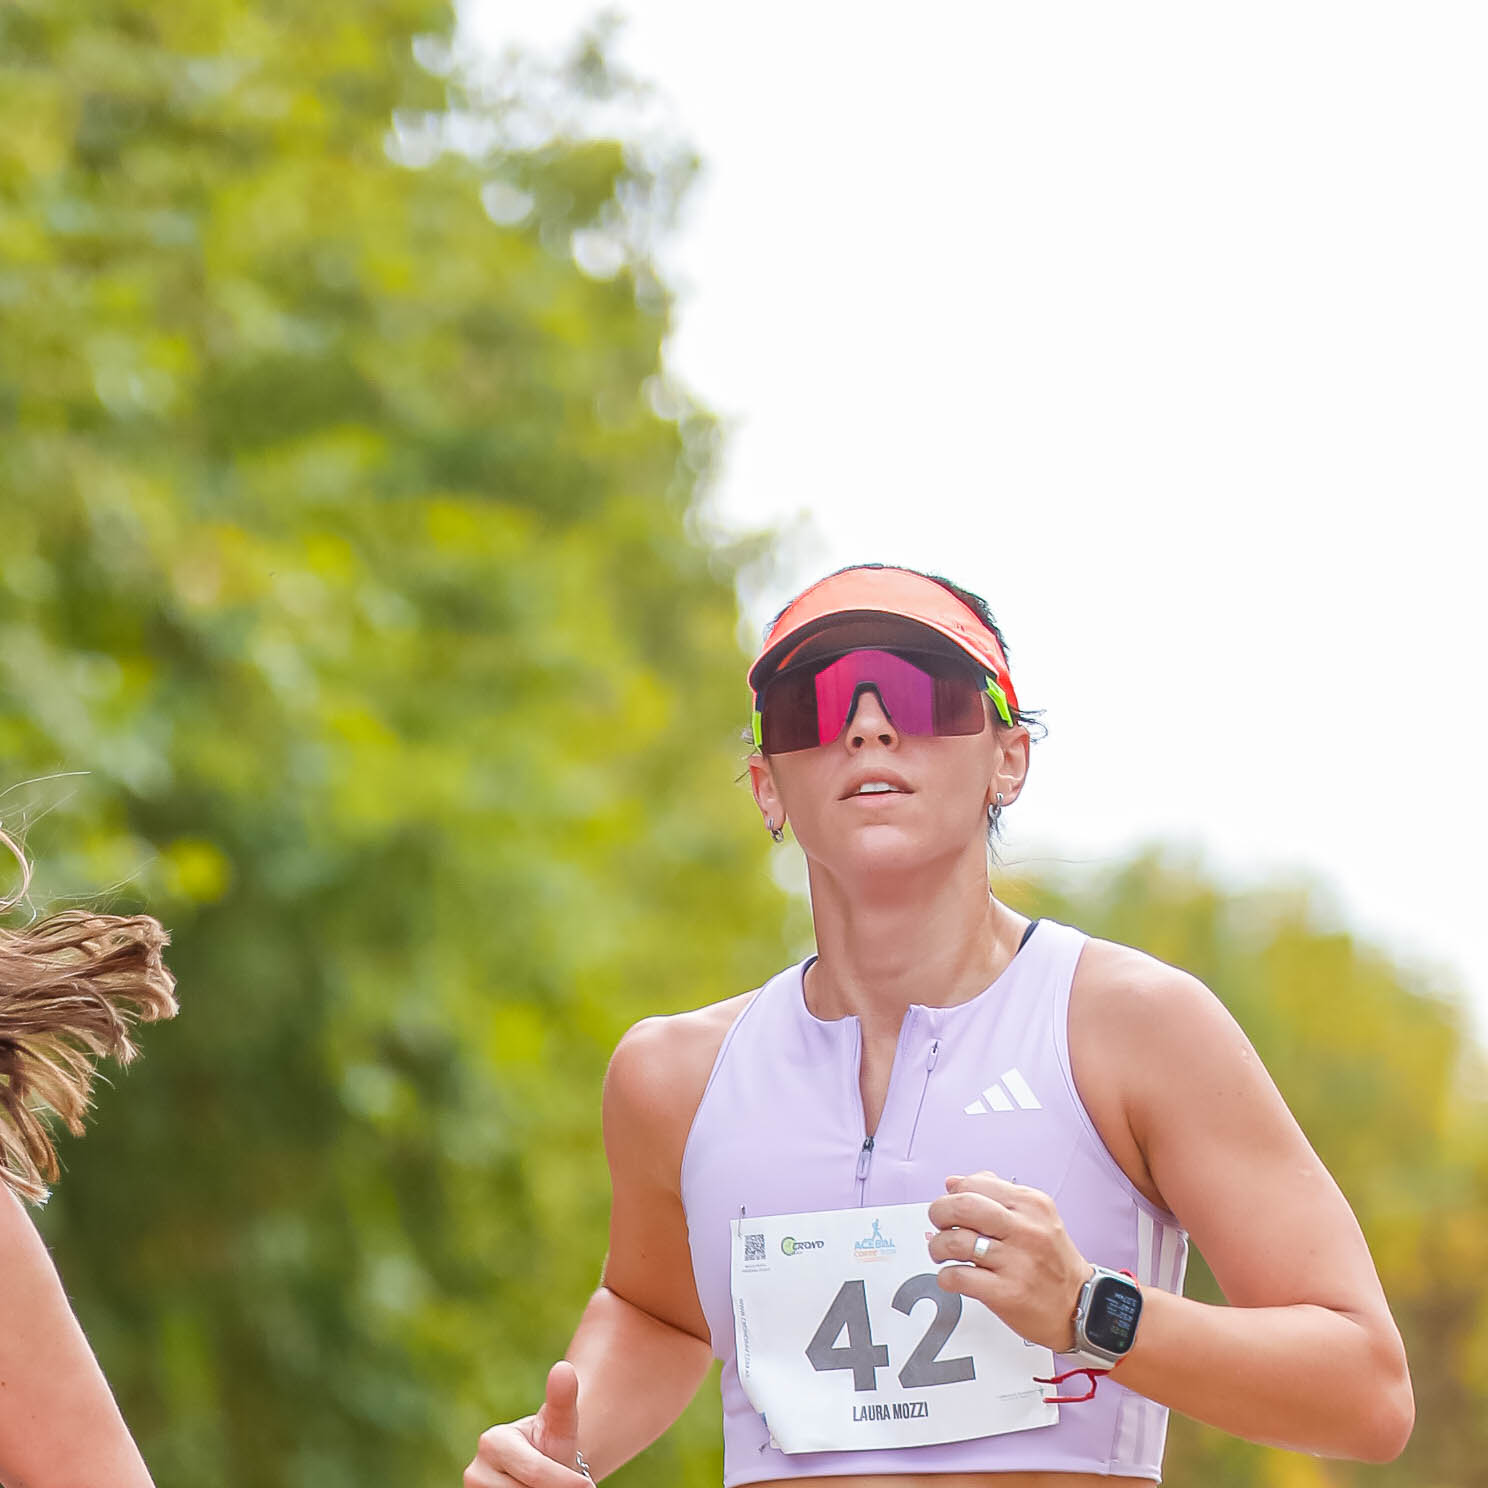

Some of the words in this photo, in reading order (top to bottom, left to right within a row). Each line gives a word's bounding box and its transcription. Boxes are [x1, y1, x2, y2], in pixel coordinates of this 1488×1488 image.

[805, 1273, 976, 1392] 42
[852, 1403, 891, 1422] LAURA
[892, 1402, 929, 1420] MOZZI
